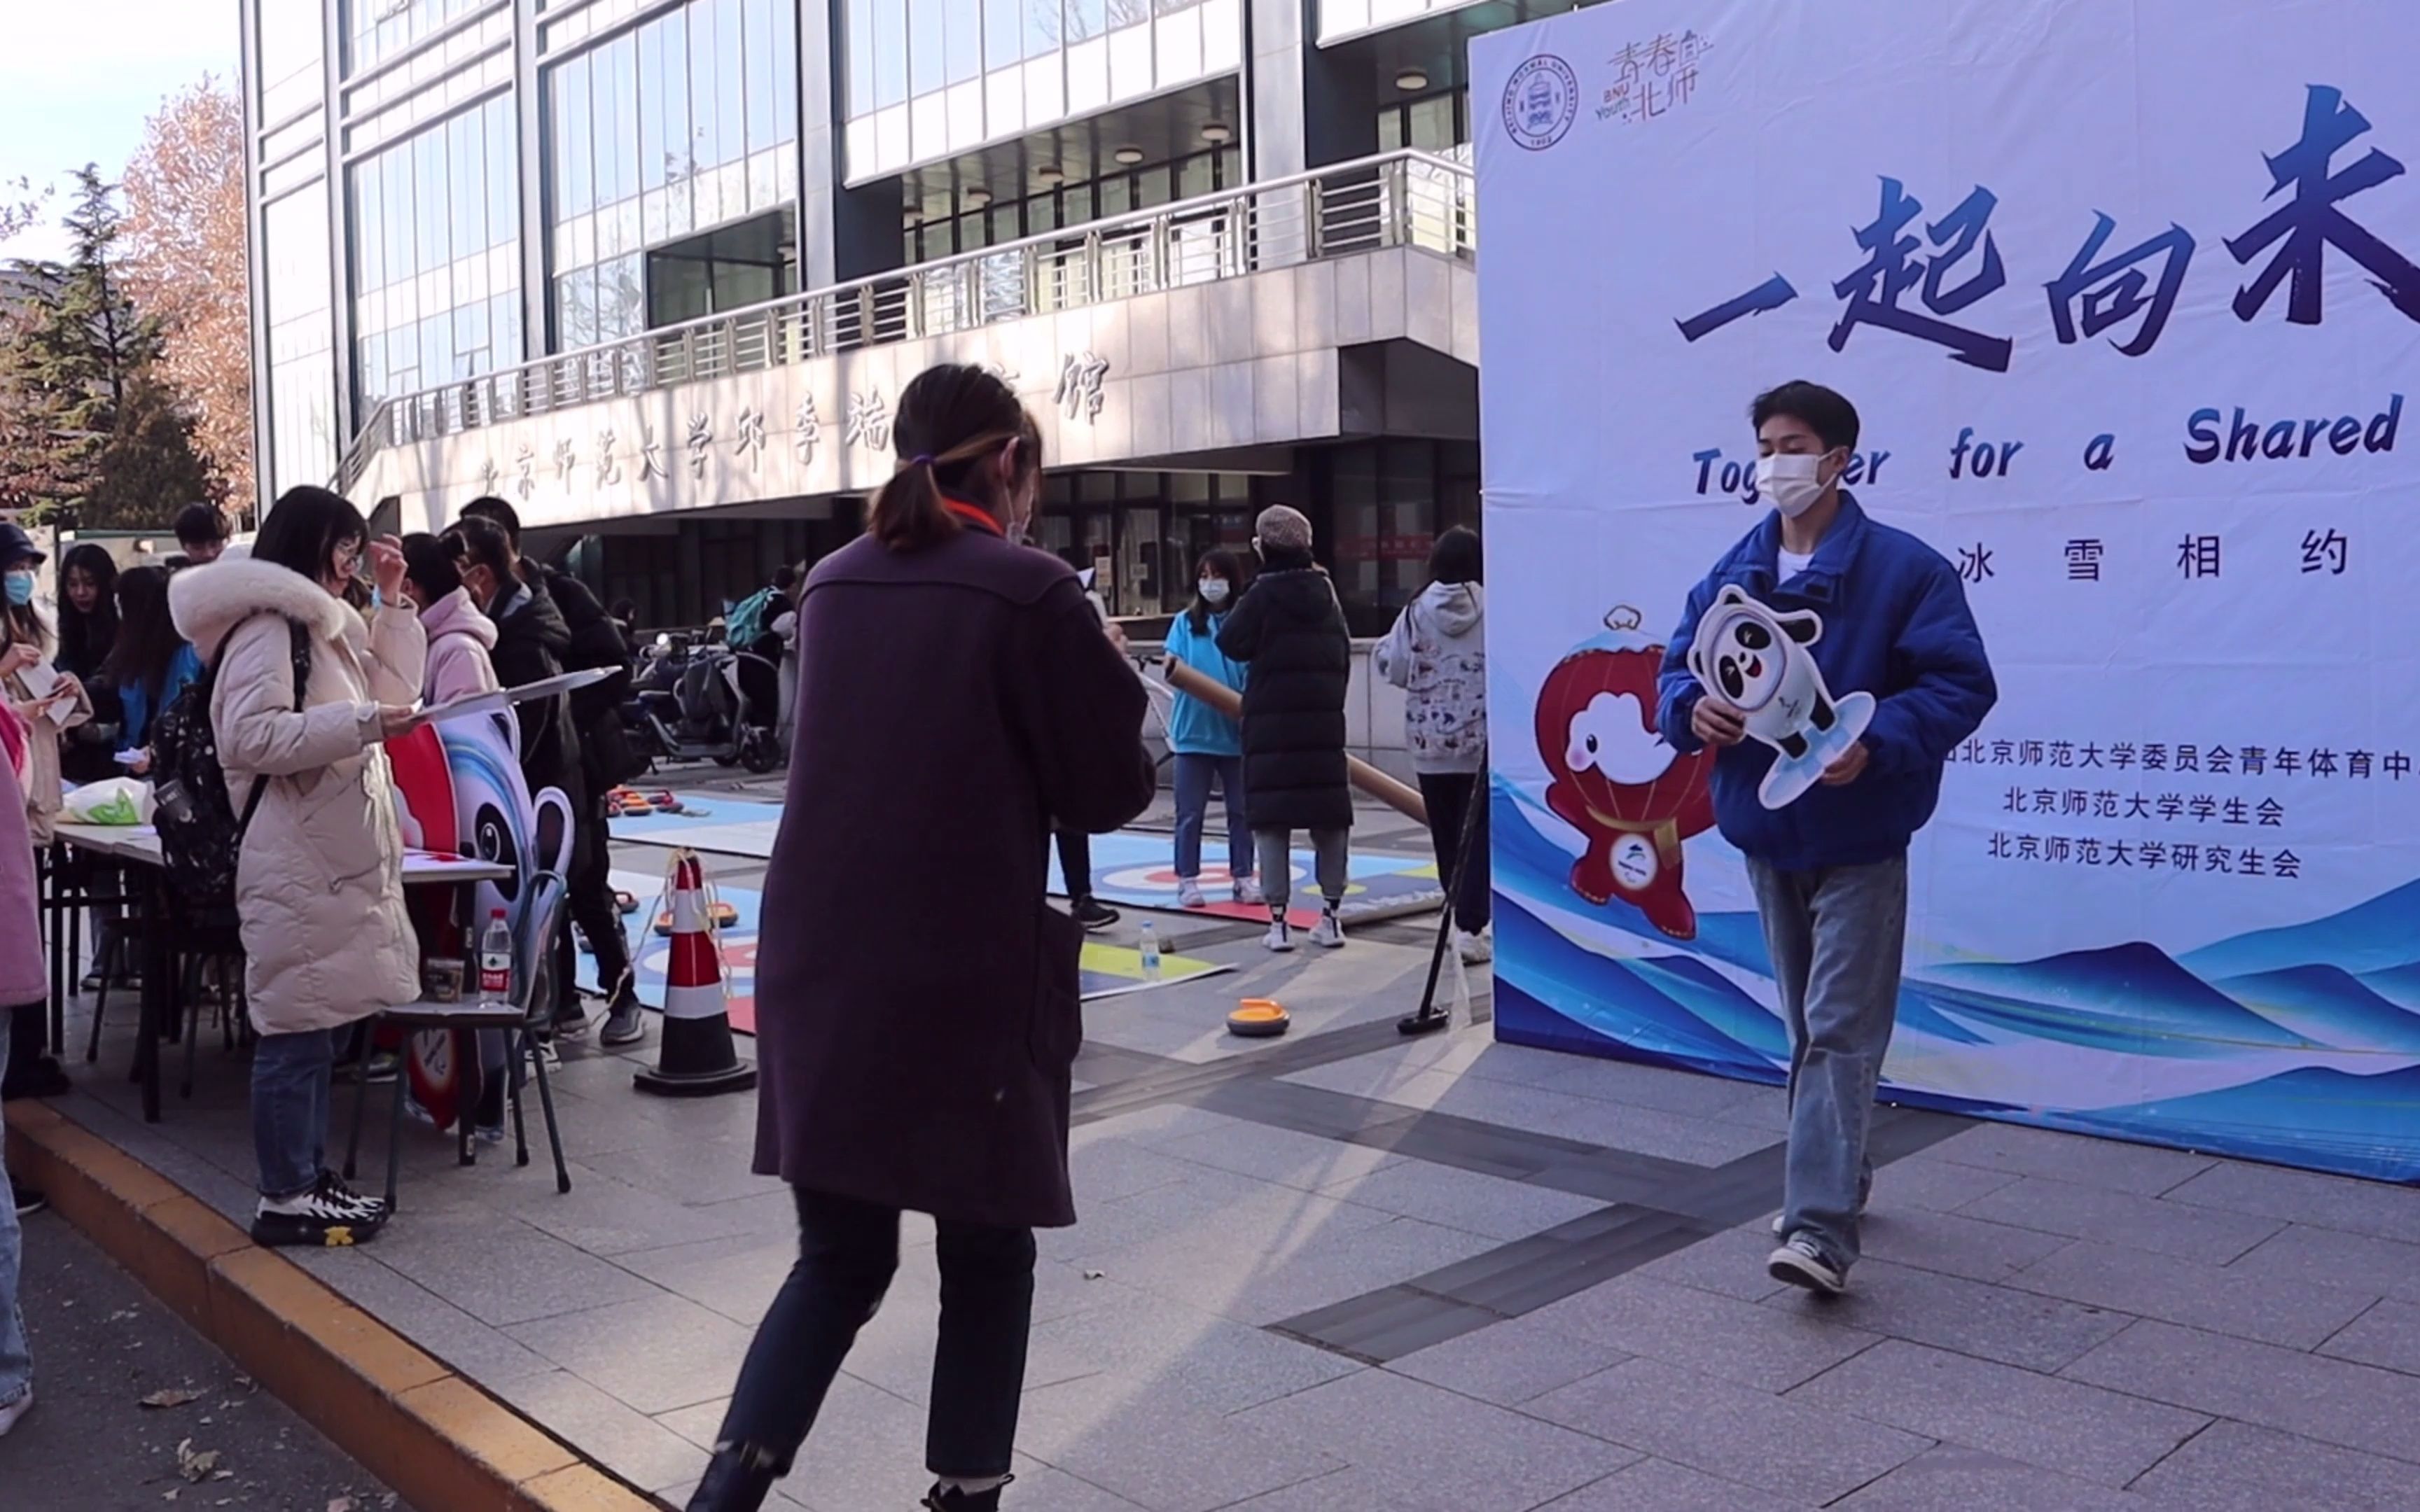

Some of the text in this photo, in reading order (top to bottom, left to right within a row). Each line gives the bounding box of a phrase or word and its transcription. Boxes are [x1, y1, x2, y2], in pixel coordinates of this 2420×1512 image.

[1949, 426, 2024, 479] for
[2084, 433, 2115, 471] a
[2183, 393, 2404, 464] Shared
[2003, 785, 2285, 827] 北京师范大学学生会
[1987, 832, 2302, 879] 北京师范大学研究生会
